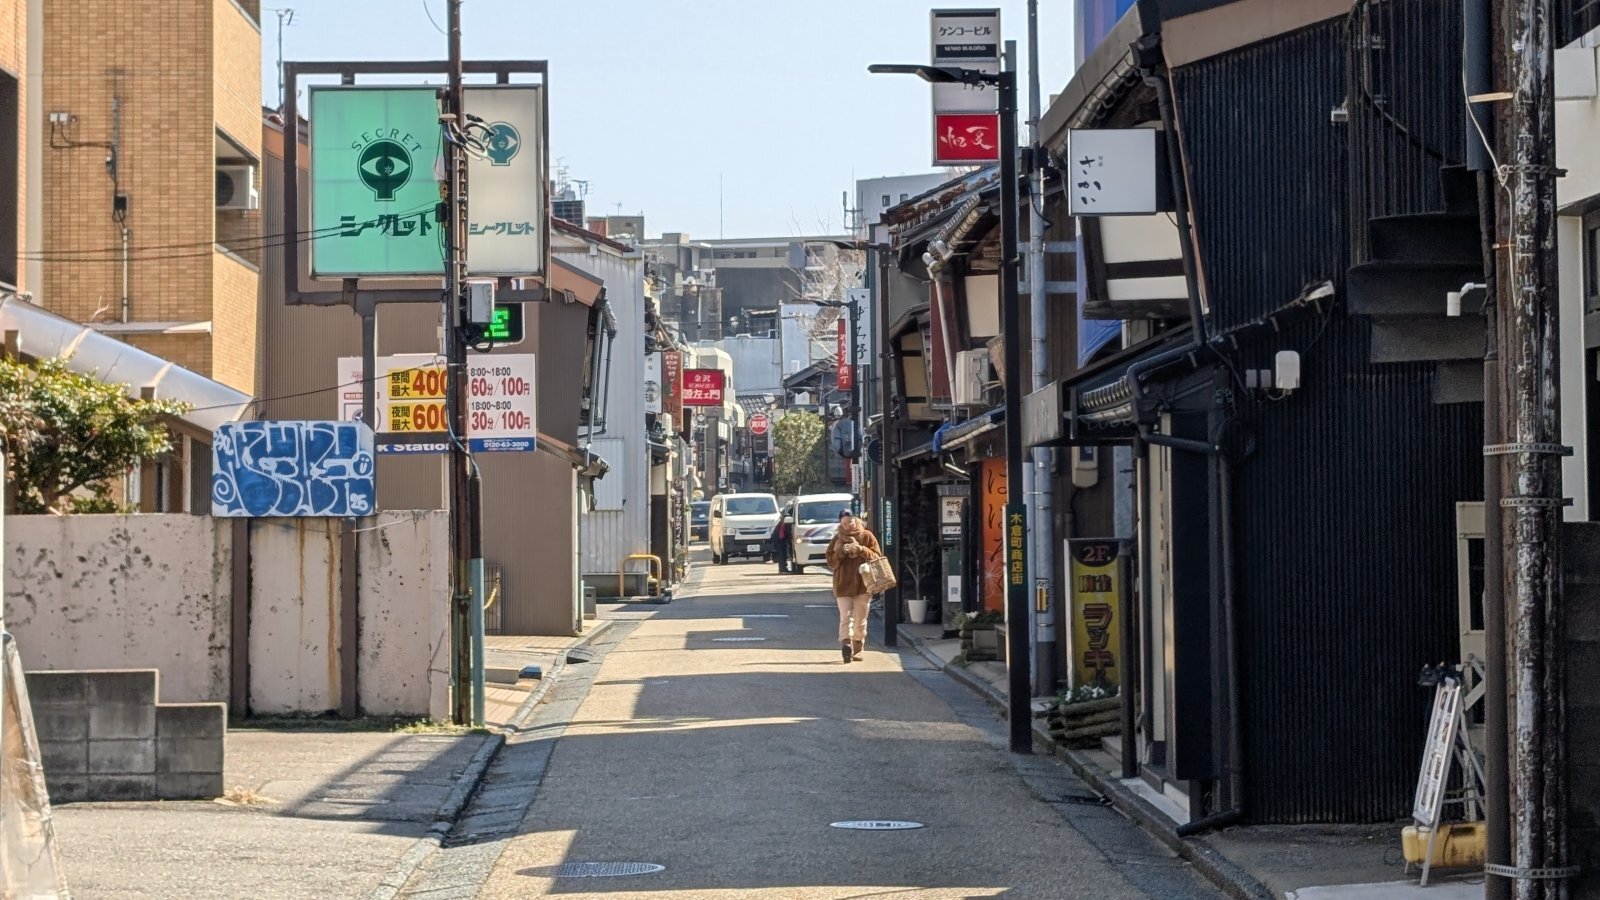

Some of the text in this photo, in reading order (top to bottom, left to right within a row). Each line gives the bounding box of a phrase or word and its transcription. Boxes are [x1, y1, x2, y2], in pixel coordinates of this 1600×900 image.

[939, 26, 992, 36] ケンコービル
[351, 127, 423, 153] SECRET
[340, 213, 433, 237] シークレット
[469, 222, 535, 236] シークレット
[391, 370, 448, 396] 昼間 400
[694, 374, 711, 382] 金沢
[391, 387, 410, 397] 最大
[391, 404, 448, 430] 夜間 600
[391, 421, 411, 431] 最大
[1010, 513, 1023, 585] 木倉町商店街
